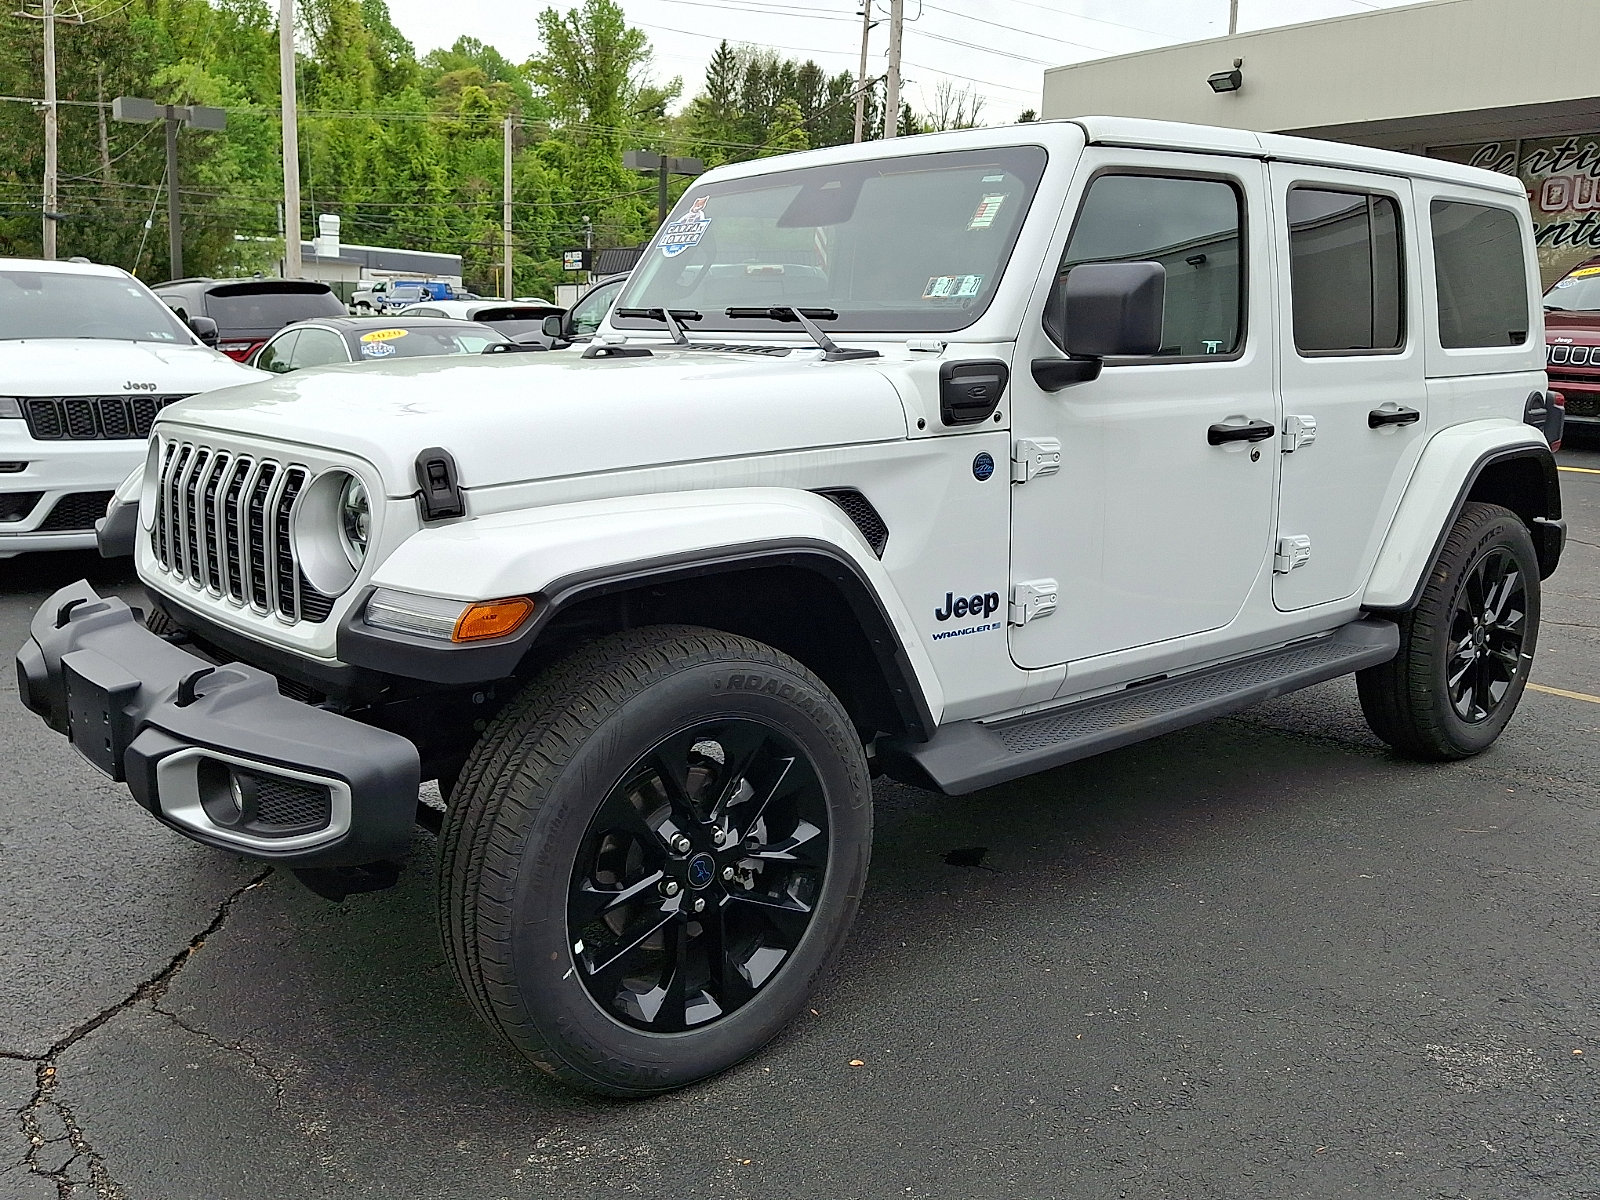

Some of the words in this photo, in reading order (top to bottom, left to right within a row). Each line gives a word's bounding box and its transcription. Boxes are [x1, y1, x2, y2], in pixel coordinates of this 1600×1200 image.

[1469, 136, 1600, 178] Certi
[371, 330, 402, 340] 2020
[1554, 336, 1573, 344] Jeep
[123, 381, 157, 392] Jeep
[935, 591, 1000, 621] Jeep
[932, 624, 991, 641] WRANGLER
